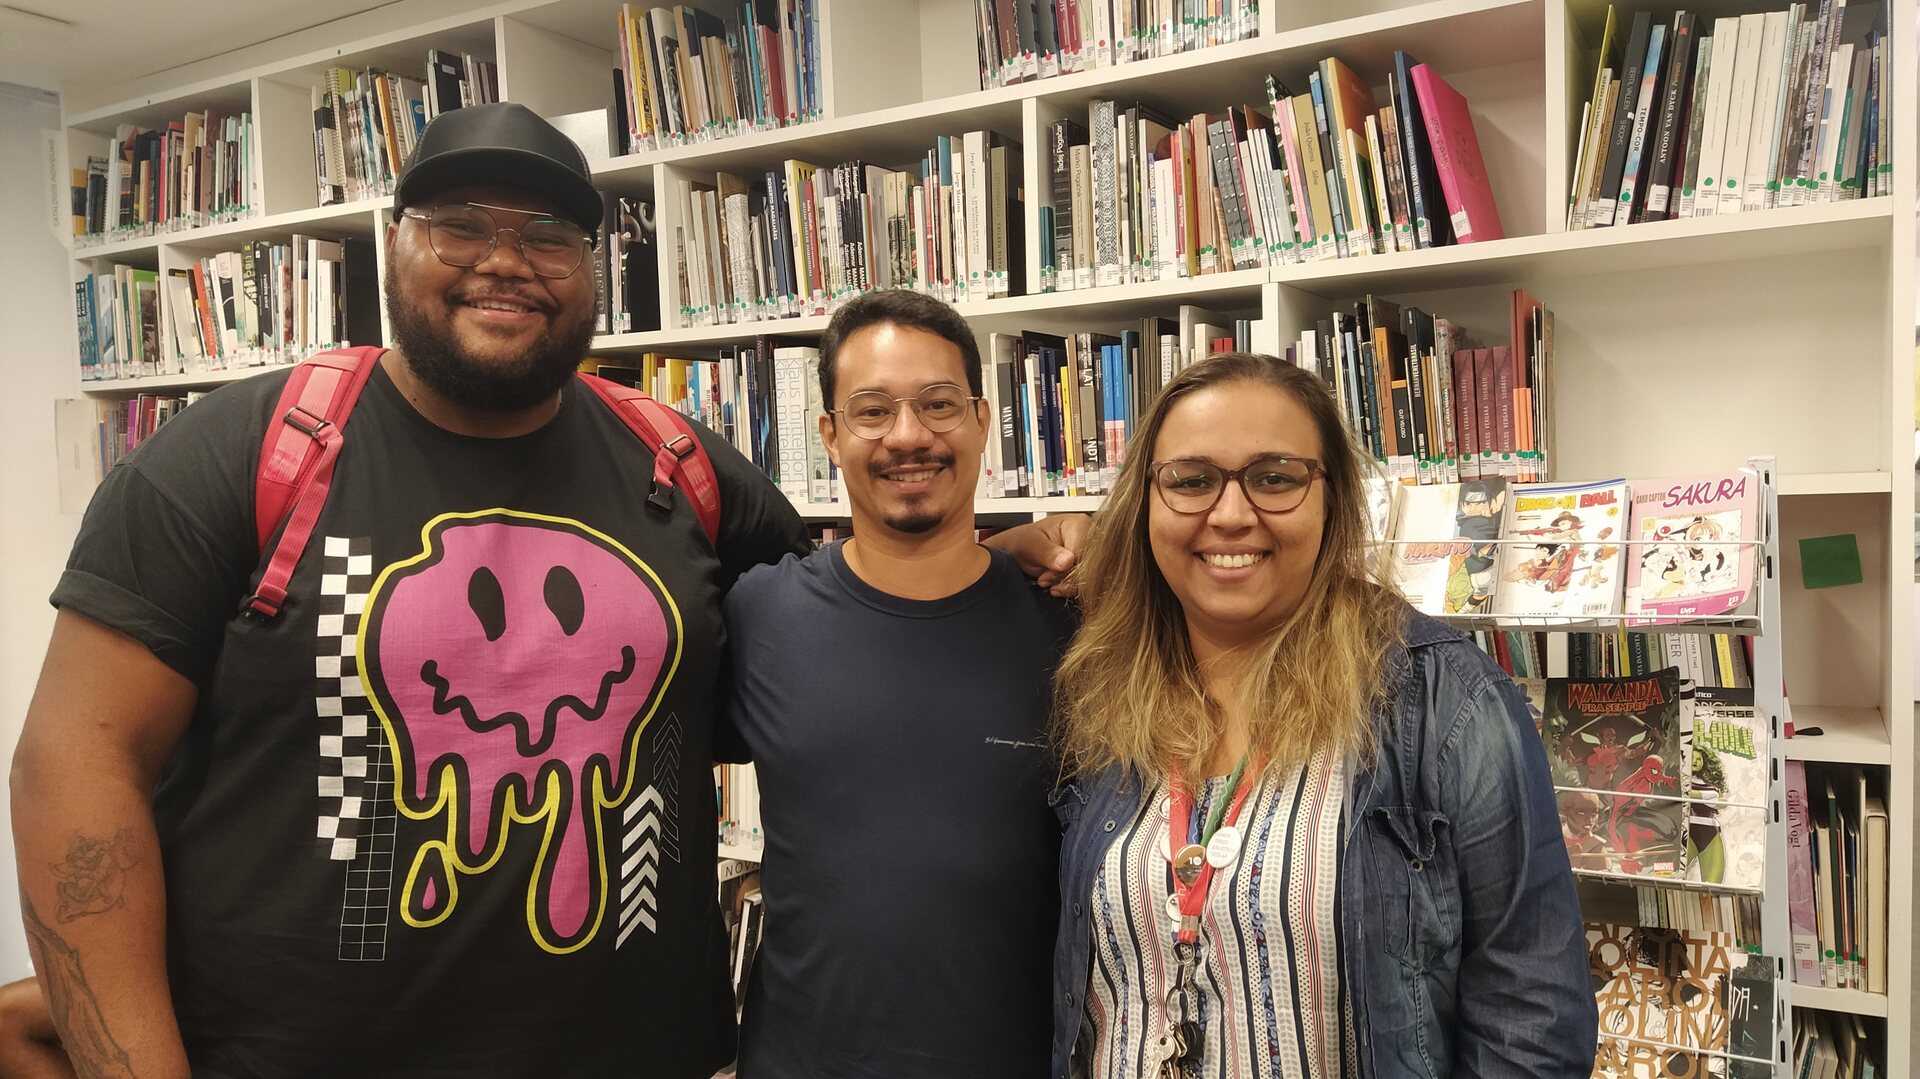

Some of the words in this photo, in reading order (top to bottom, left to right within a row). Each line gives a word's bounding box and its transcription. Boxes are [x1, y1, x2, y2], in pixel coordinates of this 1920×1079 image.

[1626, 66, 1635, 85] BERTIL
[1667, 88, 1677, 110] DYCK
[1303, 120, 1313, 135] João
[1632, 106, 1647, 151] TEMPO-COR
[1665, 111, 1673, 128] VAN
[1055, 123, 1063, 153] Pogačar
[1616, 124, 1625, 145] ROOMS
[1074, 147, 1082, 168] Marko
[1305, 135, 1316, 162] Queiroz
[1336, 139, 1344, 159] Walid
[1659, 130, 1670, 164] ANTOON
[1074, 169, 1082, 198] Pogačnik
[1101, 153, 1112, 198] SIGMAR
[1410, 164, 1418, 184] RAMOS
[1413, 184, 1421, 203] NUNO
[769, 204, 778, 241] MAGALHÃES
[1103, 200, 1113, 236] POLKE
[776, 357, 789, 399] klaus
[788, 357, 803, 398] klaus
[1002, 405, 1012, 422] MAN
[1003, 423, 1012, 437] RAY
[1515, 494, 1577, 512] DRAGON
[1579, 489, 1617, 508] BALL
[1636, 494, 1652, 504] CARD
[1663, 476, 1746, 508] SAKURA
[1403, 537, 1474, 560] NARUTO
[1633, 633, 1641, 654] COSTA
[1668, 631, 1682, 657] STER
[1688, 633, 1696, 655] NOTHER
[1635, 654, 1642, 662] DA
[1567, 678, 1665, 710] WAKANDA
[1581, 703, 1604, 712] PRA
[1606, 701, 1648, 712] SEMPRE
[1694, 710, 1754, 718] L-VERSE
[1785, 788, 1801, 821] Gilda
[1788, 822, 1803, 848] Vogt
[1653, 862, 1675, 871] MARVEL
